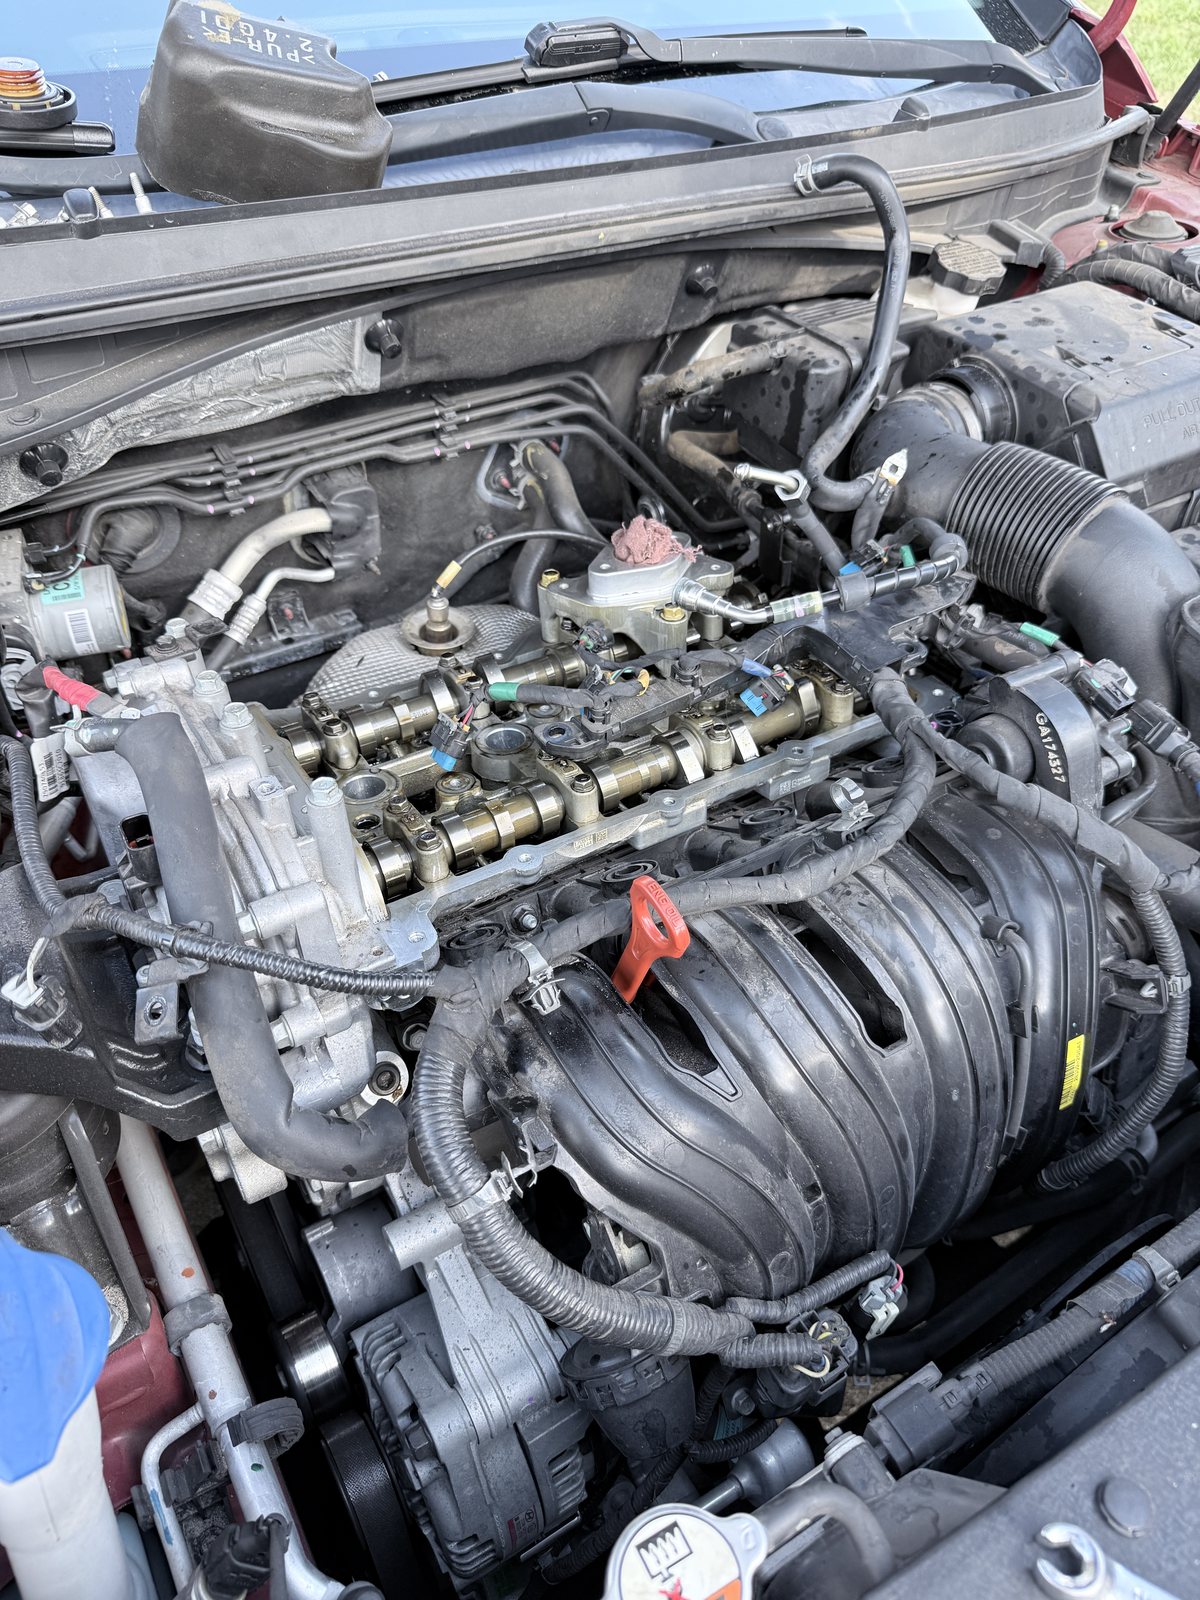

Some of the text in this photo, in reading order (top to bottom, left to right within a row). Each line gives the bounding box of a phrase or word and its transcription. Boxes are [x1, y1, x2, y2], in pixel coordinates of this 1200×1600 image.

[1035, 712, 1066, 783] GA174327
[647, 882, 685, 930] ENG OIL
